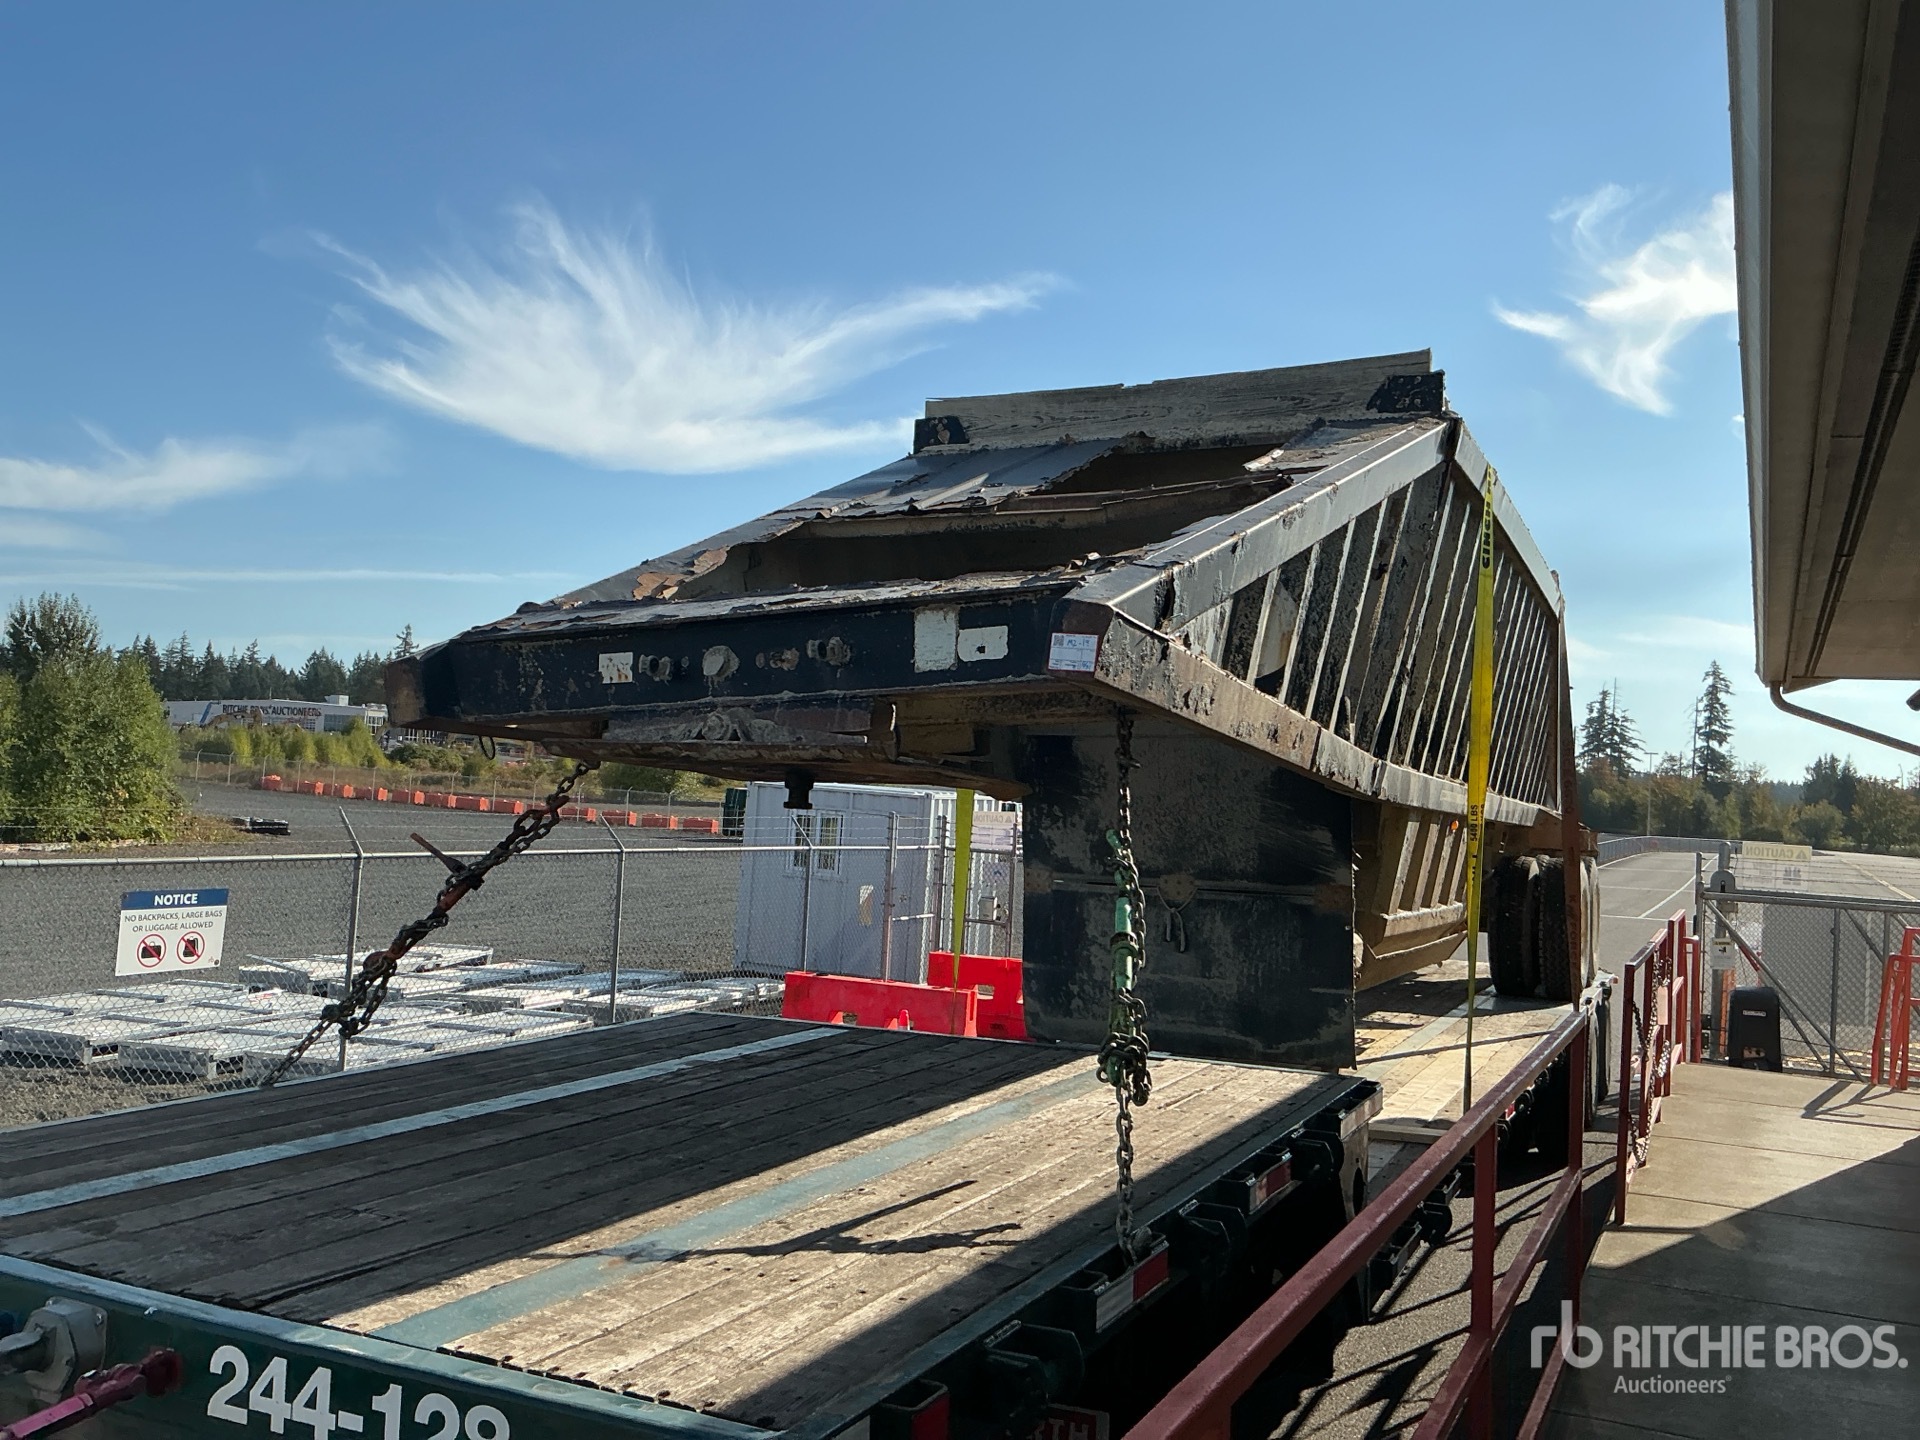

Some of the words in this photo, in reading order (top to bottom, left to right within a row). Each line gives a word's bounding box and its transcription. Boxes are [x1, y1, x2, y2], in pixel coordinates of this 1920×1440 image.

[154, 893, 198, 906] NOTICE
[124, 914, 137, 922] NO
[138, 912, 181, 922] BACKPACKS,
[182, 910, 204, 919] LARGE
[205, 909, 223, 918] BAGS
[145, 922, 179, 932] LUGGAGE
[180, 920, 214, 930] ALLOWED
